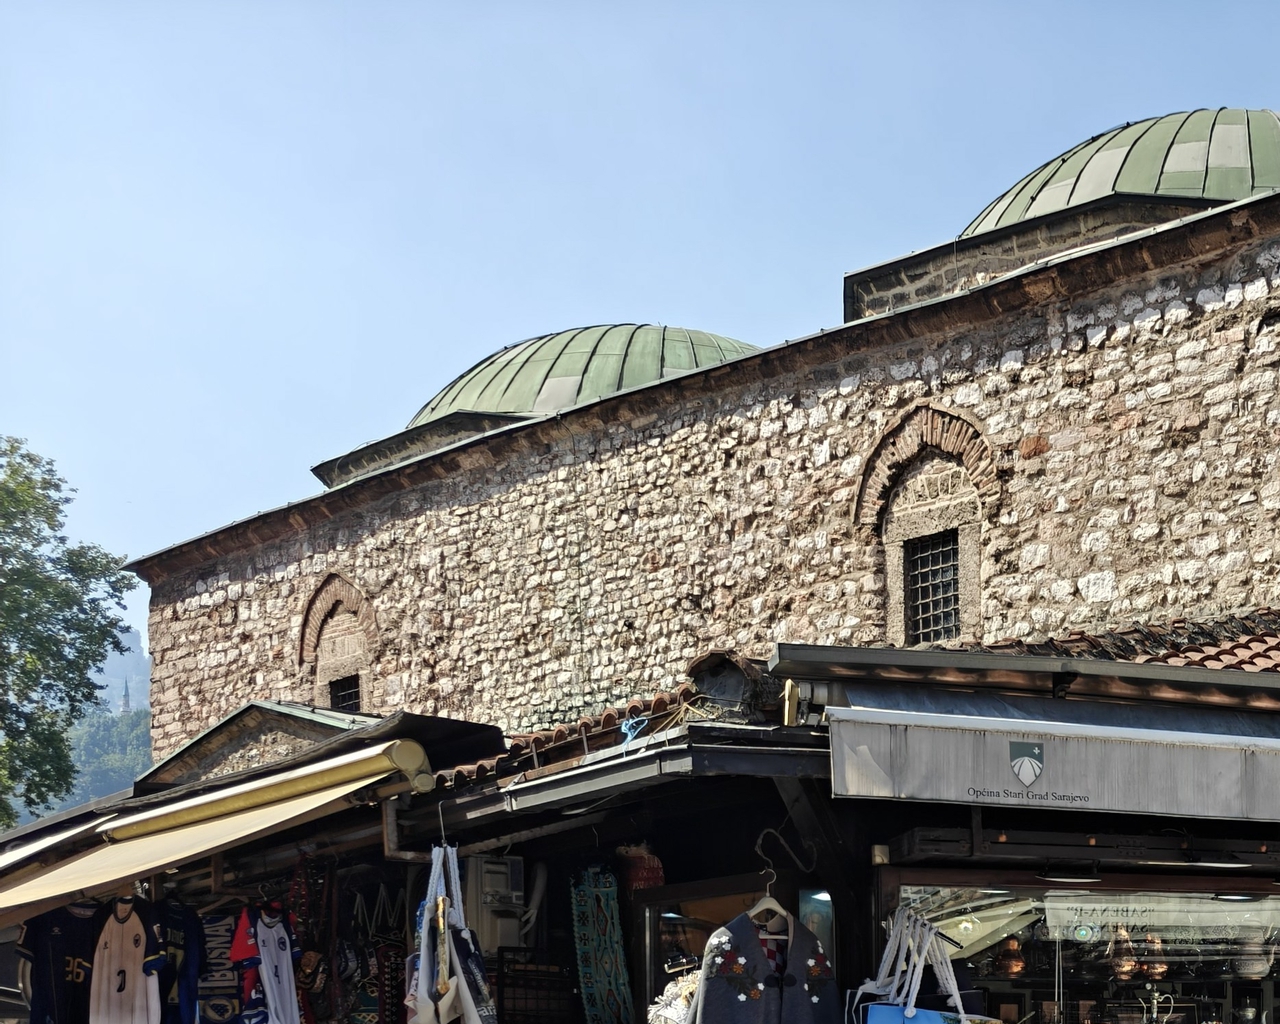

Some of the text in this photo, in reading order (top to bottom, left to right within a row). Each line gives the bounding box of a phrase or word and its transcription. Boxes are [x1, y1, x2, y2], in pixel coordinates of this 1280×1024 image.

[967, 786, 1090, 804] Općina Stari Grad Sarajevo
